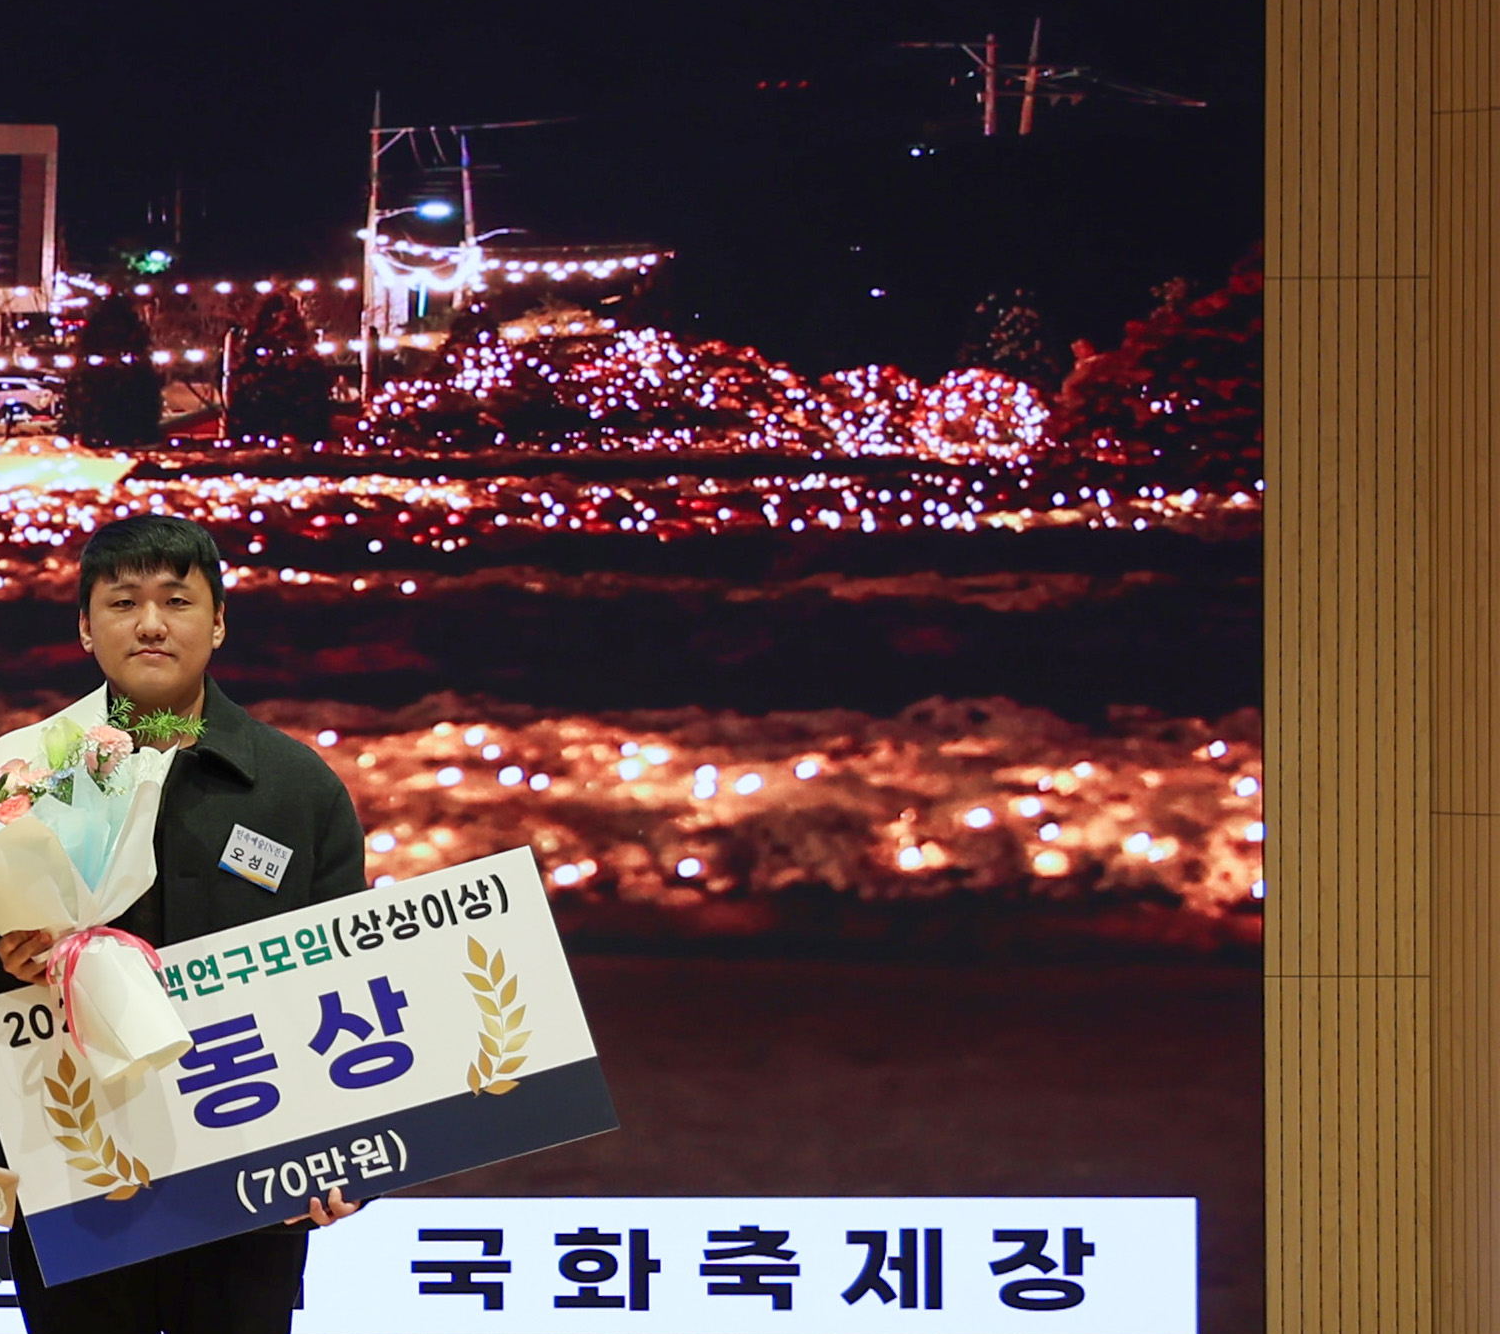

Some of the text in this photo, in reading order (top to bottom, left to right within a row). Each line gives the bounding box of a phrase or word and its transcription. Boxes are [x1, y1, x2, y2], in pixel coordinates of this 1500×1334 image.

[154, 872, 509, 1003] 책연구모임(상상이상)
[235, 1128, 409, 1214] (70만원)
[410, 1224, 1097, 1313] 국화축제장
